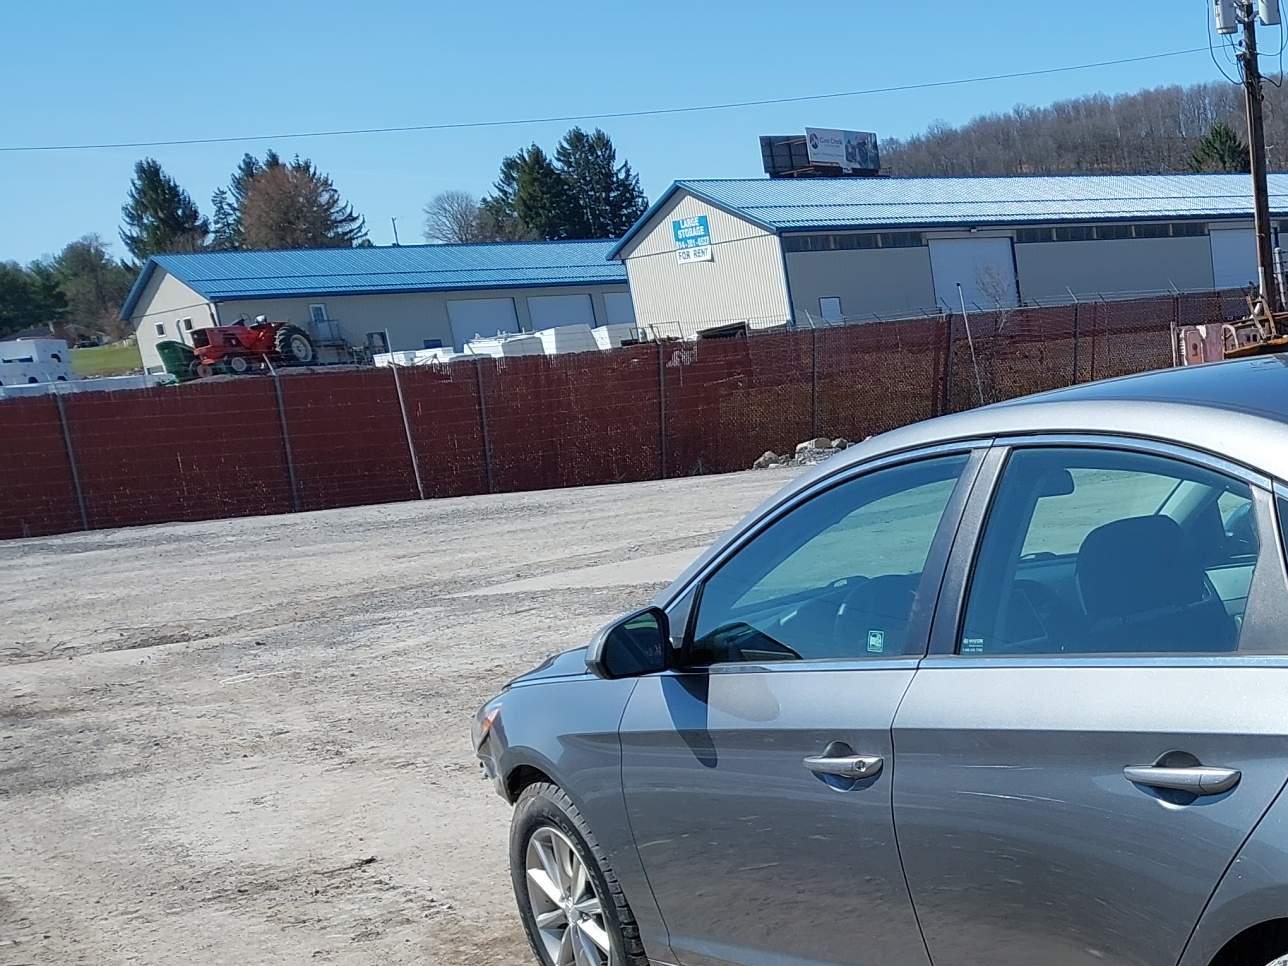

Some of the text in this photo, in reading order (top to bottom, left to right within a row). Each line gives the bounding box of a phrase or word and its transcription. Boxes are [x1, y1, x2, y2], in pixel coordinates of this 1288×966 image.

[680, 217, 700, 229] LARGE
[677, 226, 705, 240] STORAGE
[678, 247, 709, 261] FOR RENT
